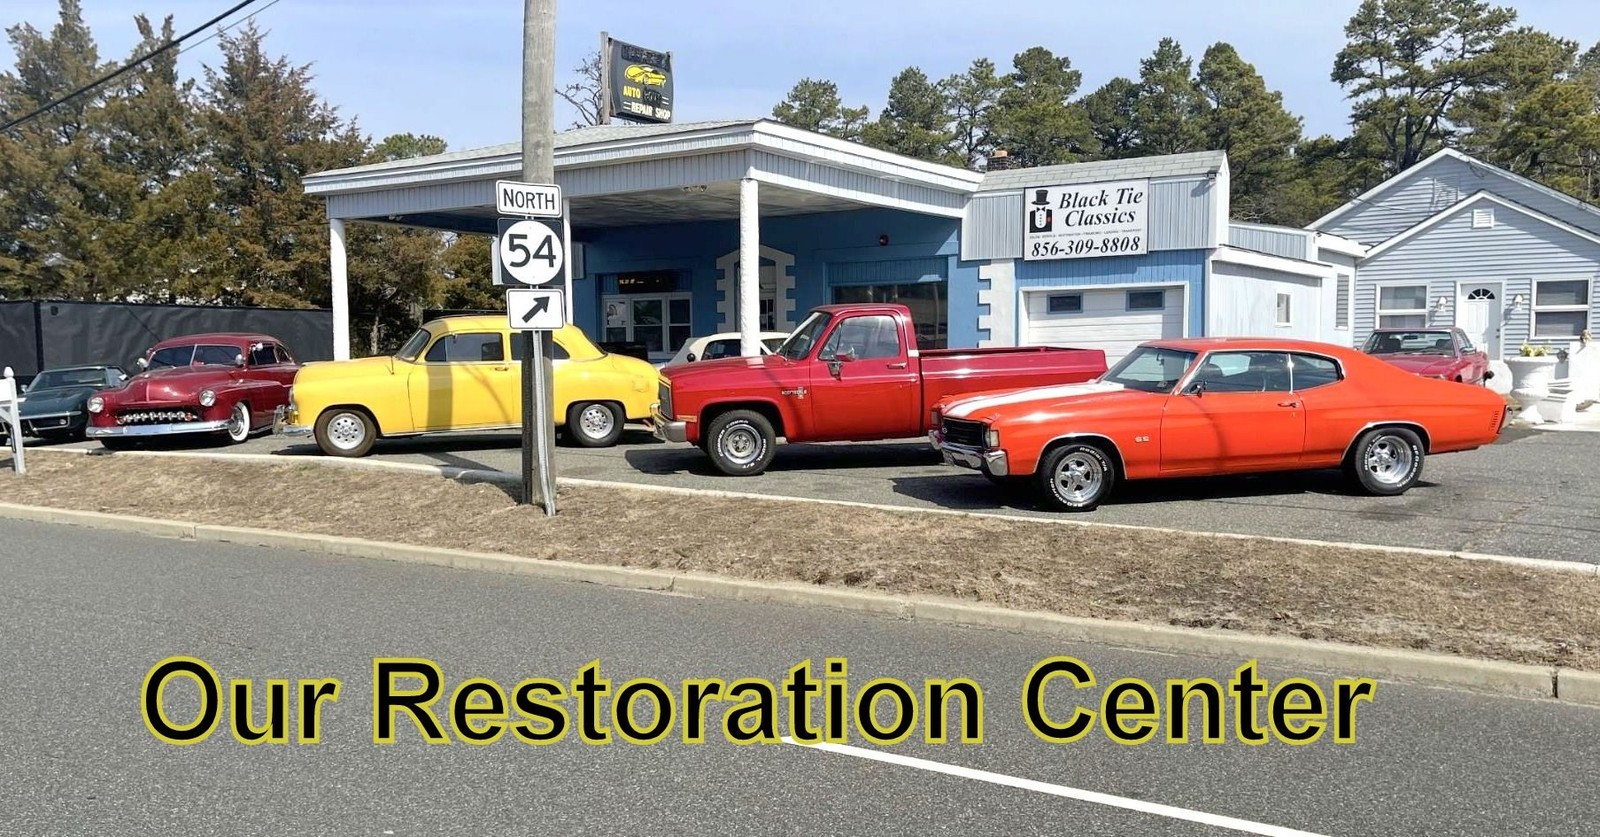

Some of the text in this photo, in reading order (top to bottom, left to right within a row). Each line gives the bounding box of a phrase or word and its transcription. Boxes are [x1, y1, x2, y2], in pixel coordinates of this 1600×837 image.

[623, 85, 641, 99] AUTO
[631, 101, 671, 120] REPAIR SHOP
[503, 188, 555, 210] NORTH
[1060, 187, 1143, 209] Black Tie
[1065, 207, 1136, 227] Classics
[508, 233, 557, 268] 54
[1031, 236, 1141, 258] 856-309-8808
